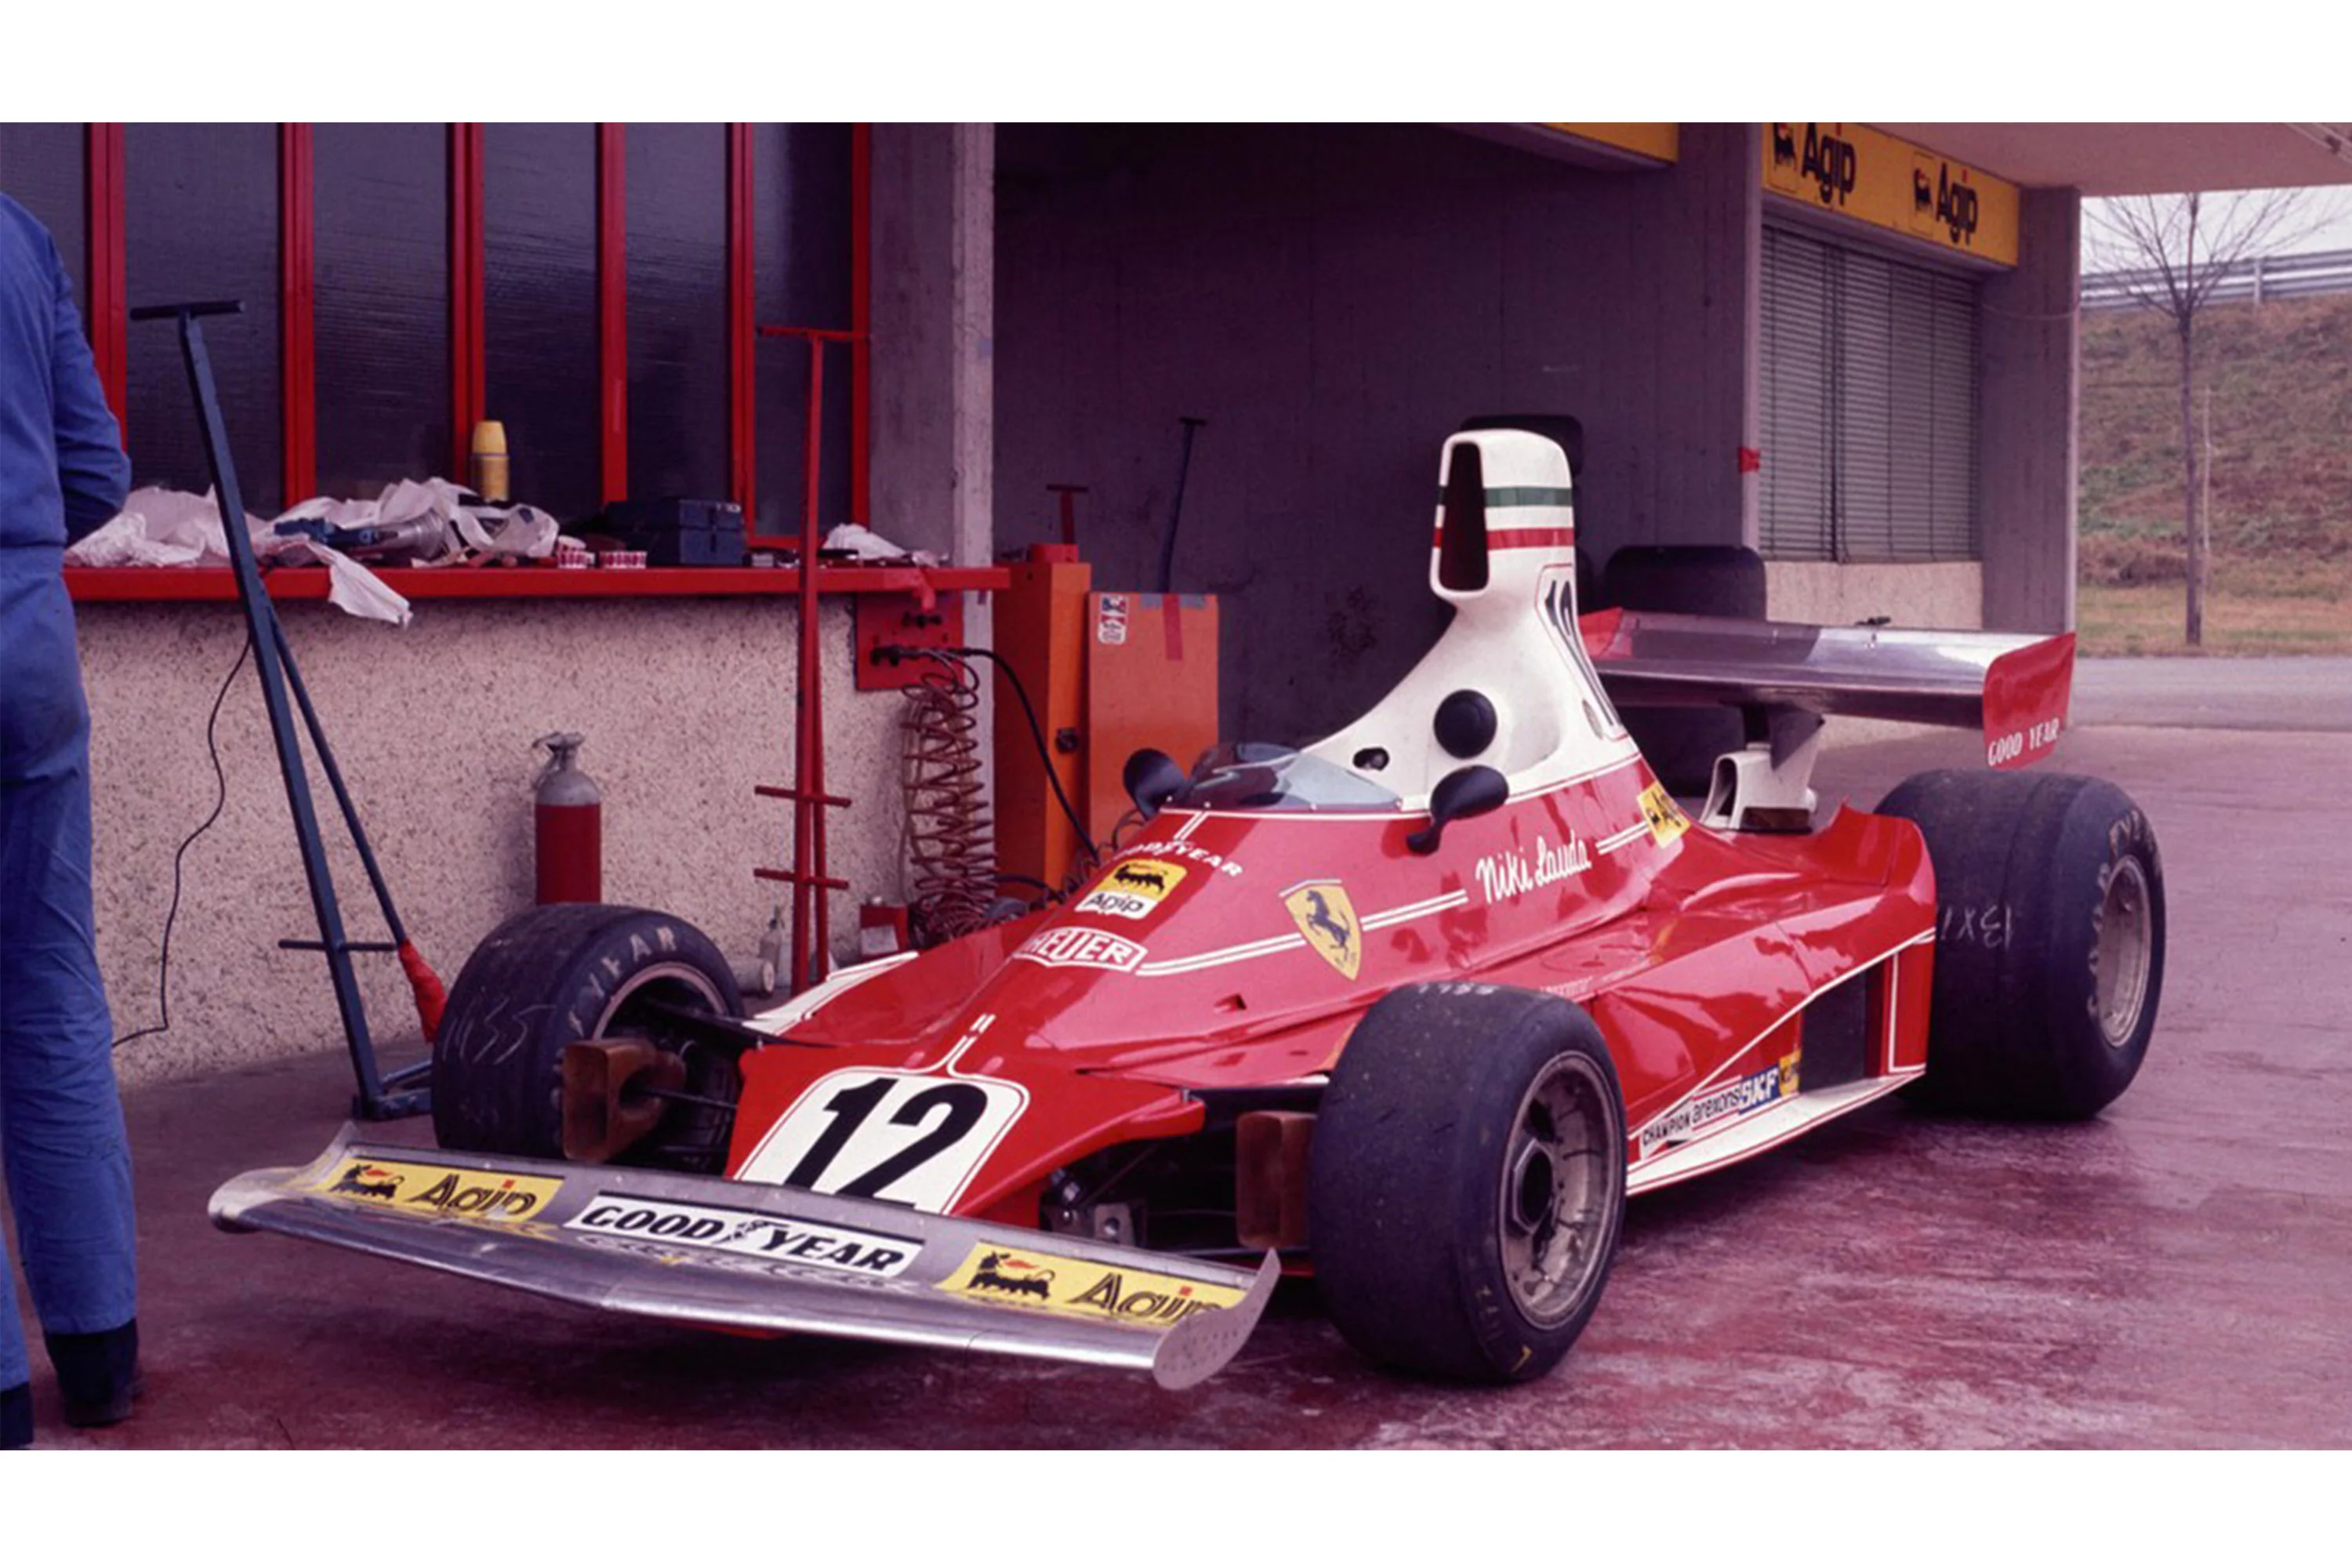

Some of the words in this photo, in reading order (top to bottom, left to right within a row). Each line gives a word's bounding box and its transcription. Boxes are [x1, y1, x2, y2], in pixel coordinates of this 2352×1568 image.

[1802, 123, 1857, 207] Agip
[1936, 162, 1978, 246] Agip
[1987, 729, 2023, 767] GOOD
[2029, 717, 2059, 750] YEAR
[1475, 846, 1534, 904] Niki
[1534, 829, 1592, 887] Lauda
[1088, 892, 1144, 915] Agip
[1026, 928, 1133, 965] HEUER
[1740, 1066, 1779, 1110] SKF
[784, 1077, 988, 1209] 12
[404, 1173, 538, 1215] Agip
[580, 1204, 726, 1241] GOOD
[759, 1226, 906, 1272] YEAR
